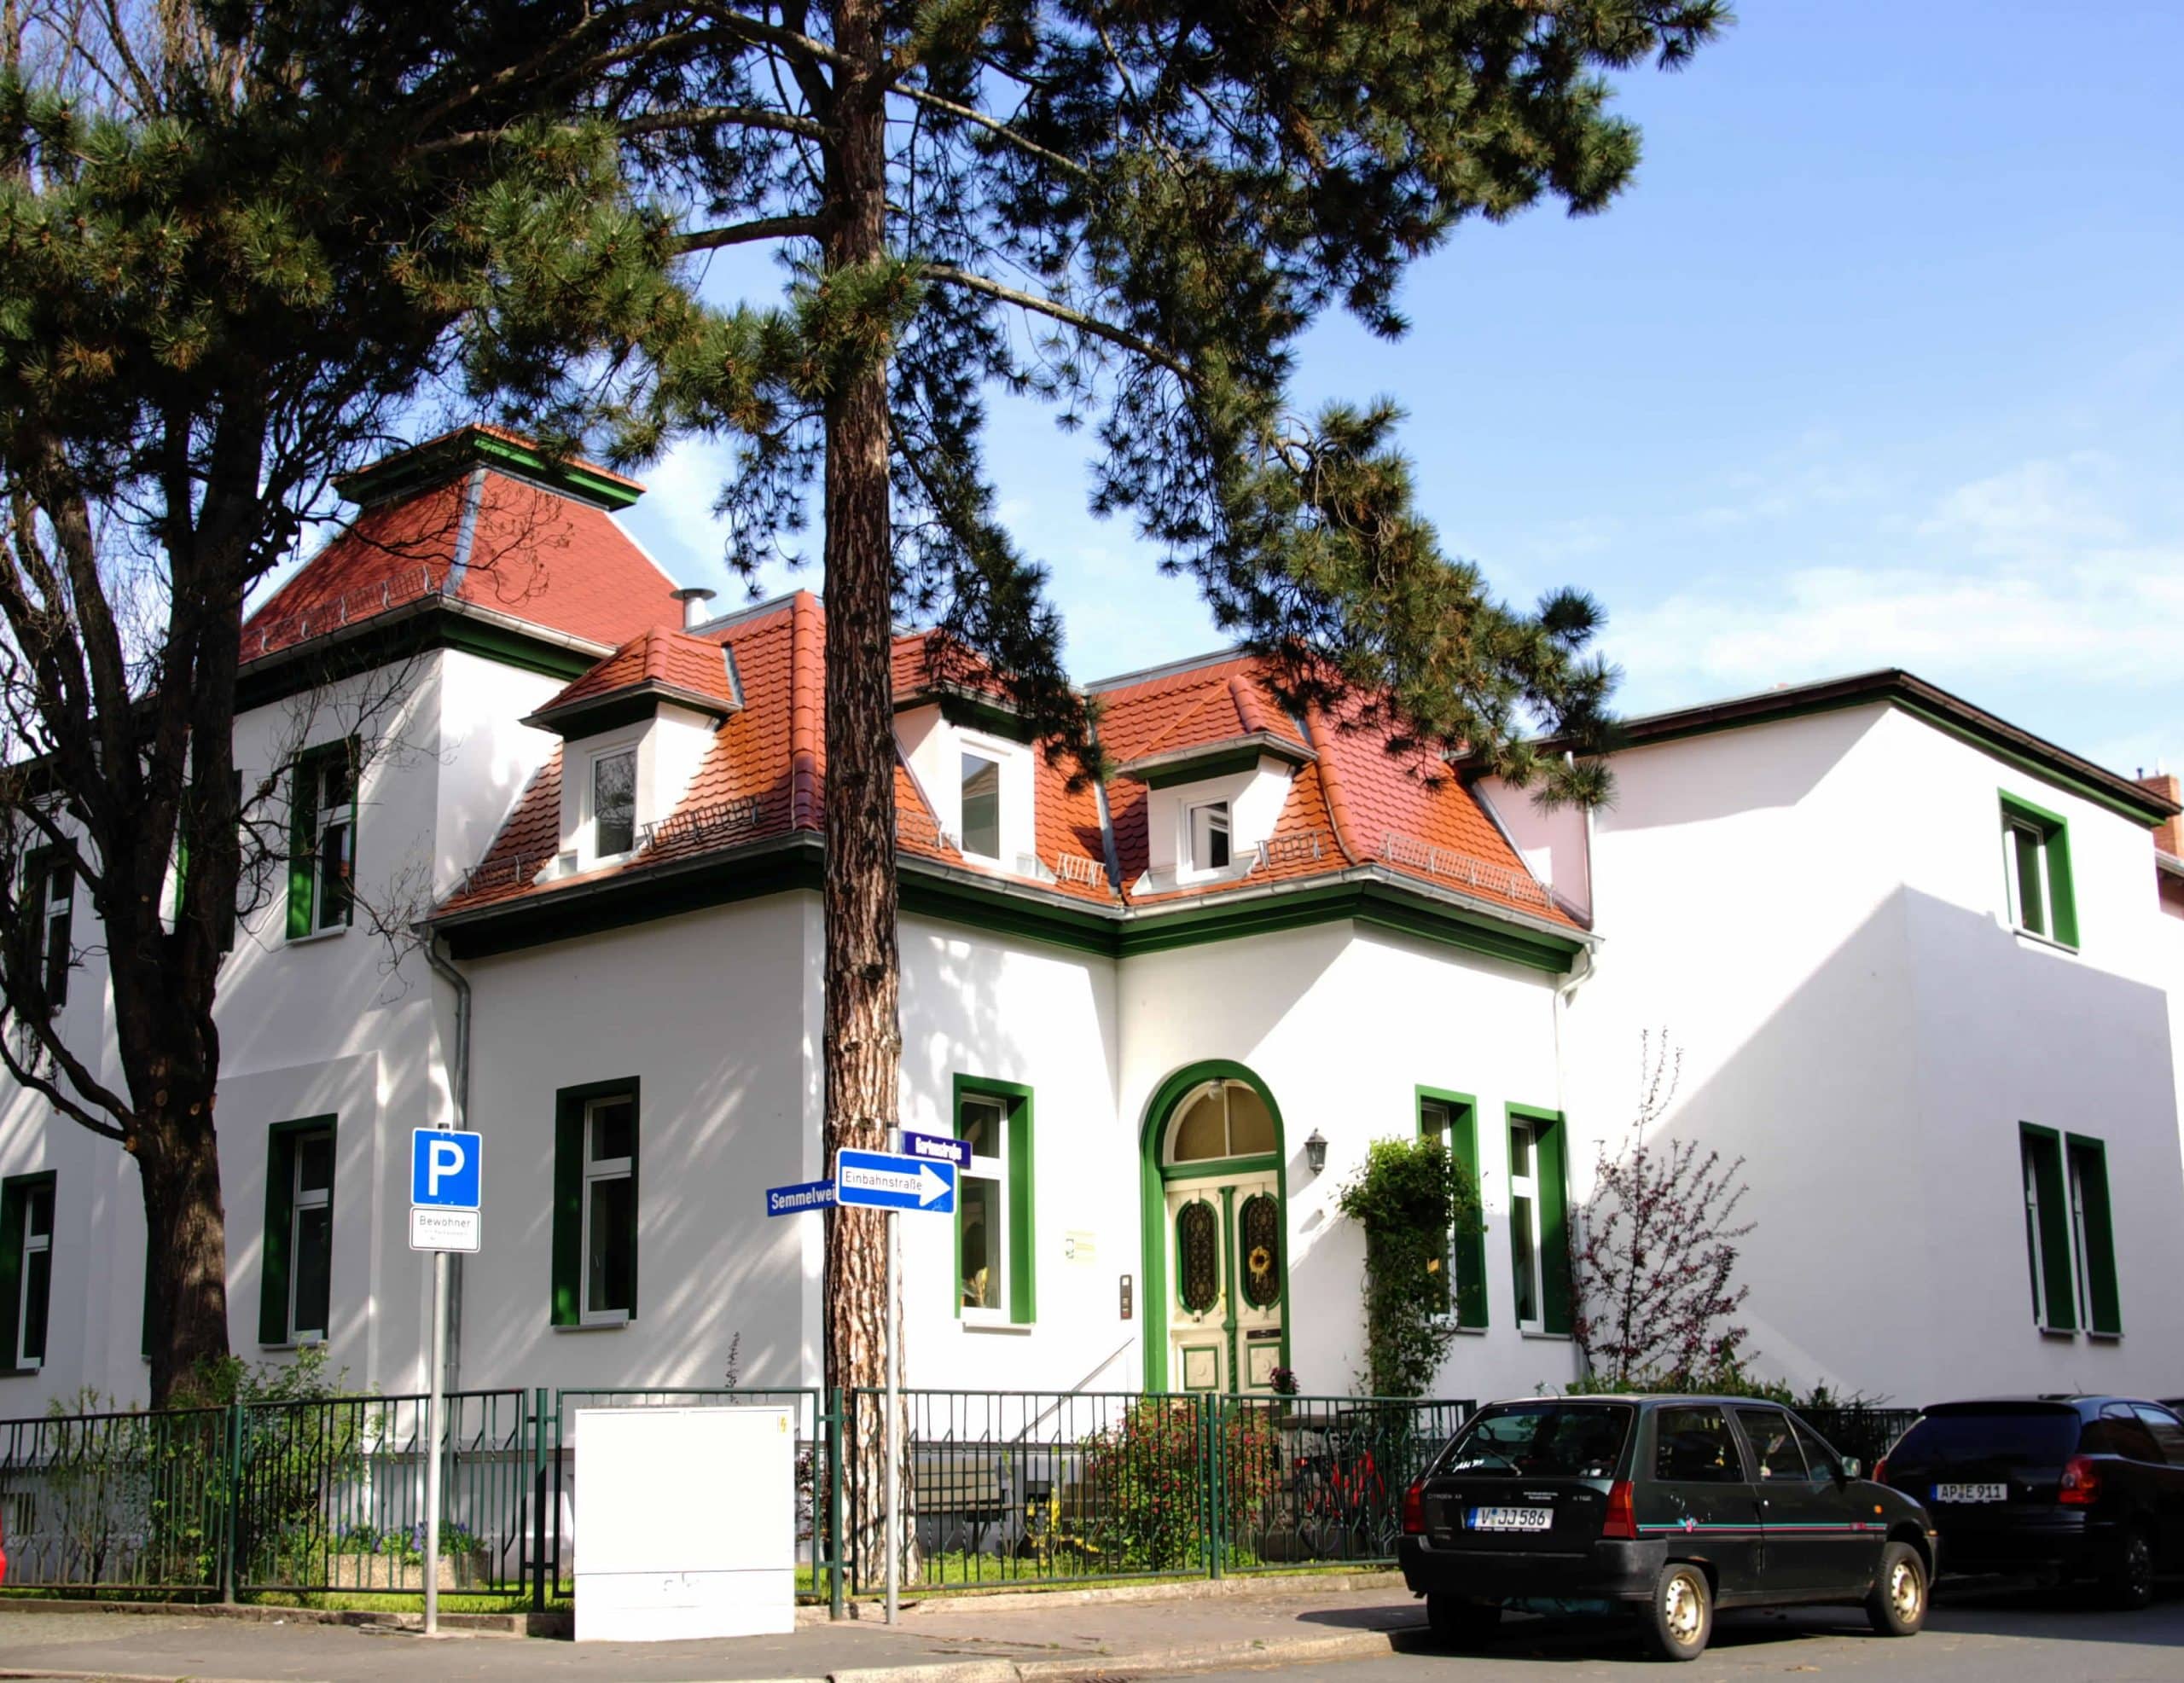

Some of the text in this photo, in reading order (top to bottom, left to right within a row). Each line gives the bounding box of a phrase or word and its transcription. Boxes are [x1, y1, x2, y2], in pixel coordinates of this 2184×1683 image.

[428, 1140, 465, 1196] P
[845, 1170, 922, 1192] Einbahnstraße
[419, 1215, 470, 1227] Bewohner
[1942, 1485, 2001, 1498] AP E 911
[1481, 1508, 1546, 1525] V JJ 586
